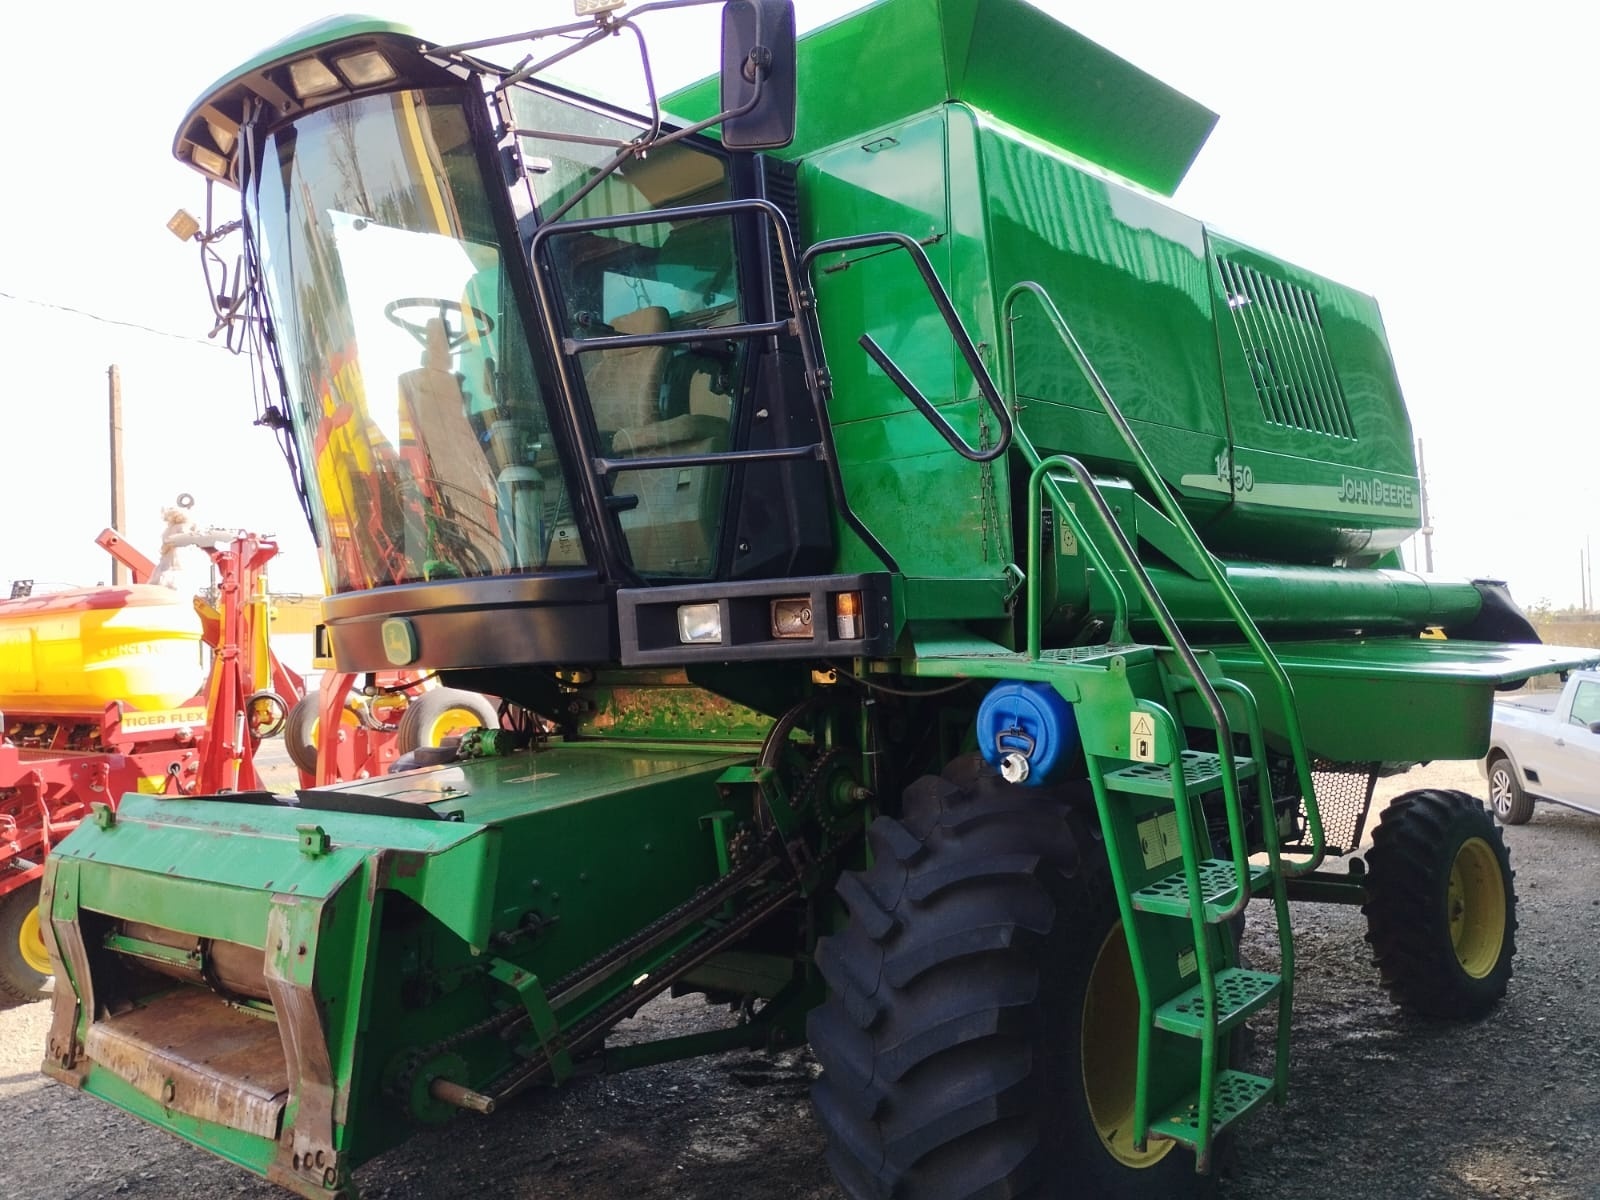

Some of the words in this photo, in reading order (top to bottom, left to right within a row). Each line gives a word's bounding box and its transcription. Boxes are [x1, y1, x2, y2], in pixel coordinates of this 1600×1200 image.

[1337, 473, 1372, 505] JOHN
[1372, 478, 1414, 509] DEERE
[124, 715, 166, 727] TIGER
[170, 712, 204, 724] FLEX
